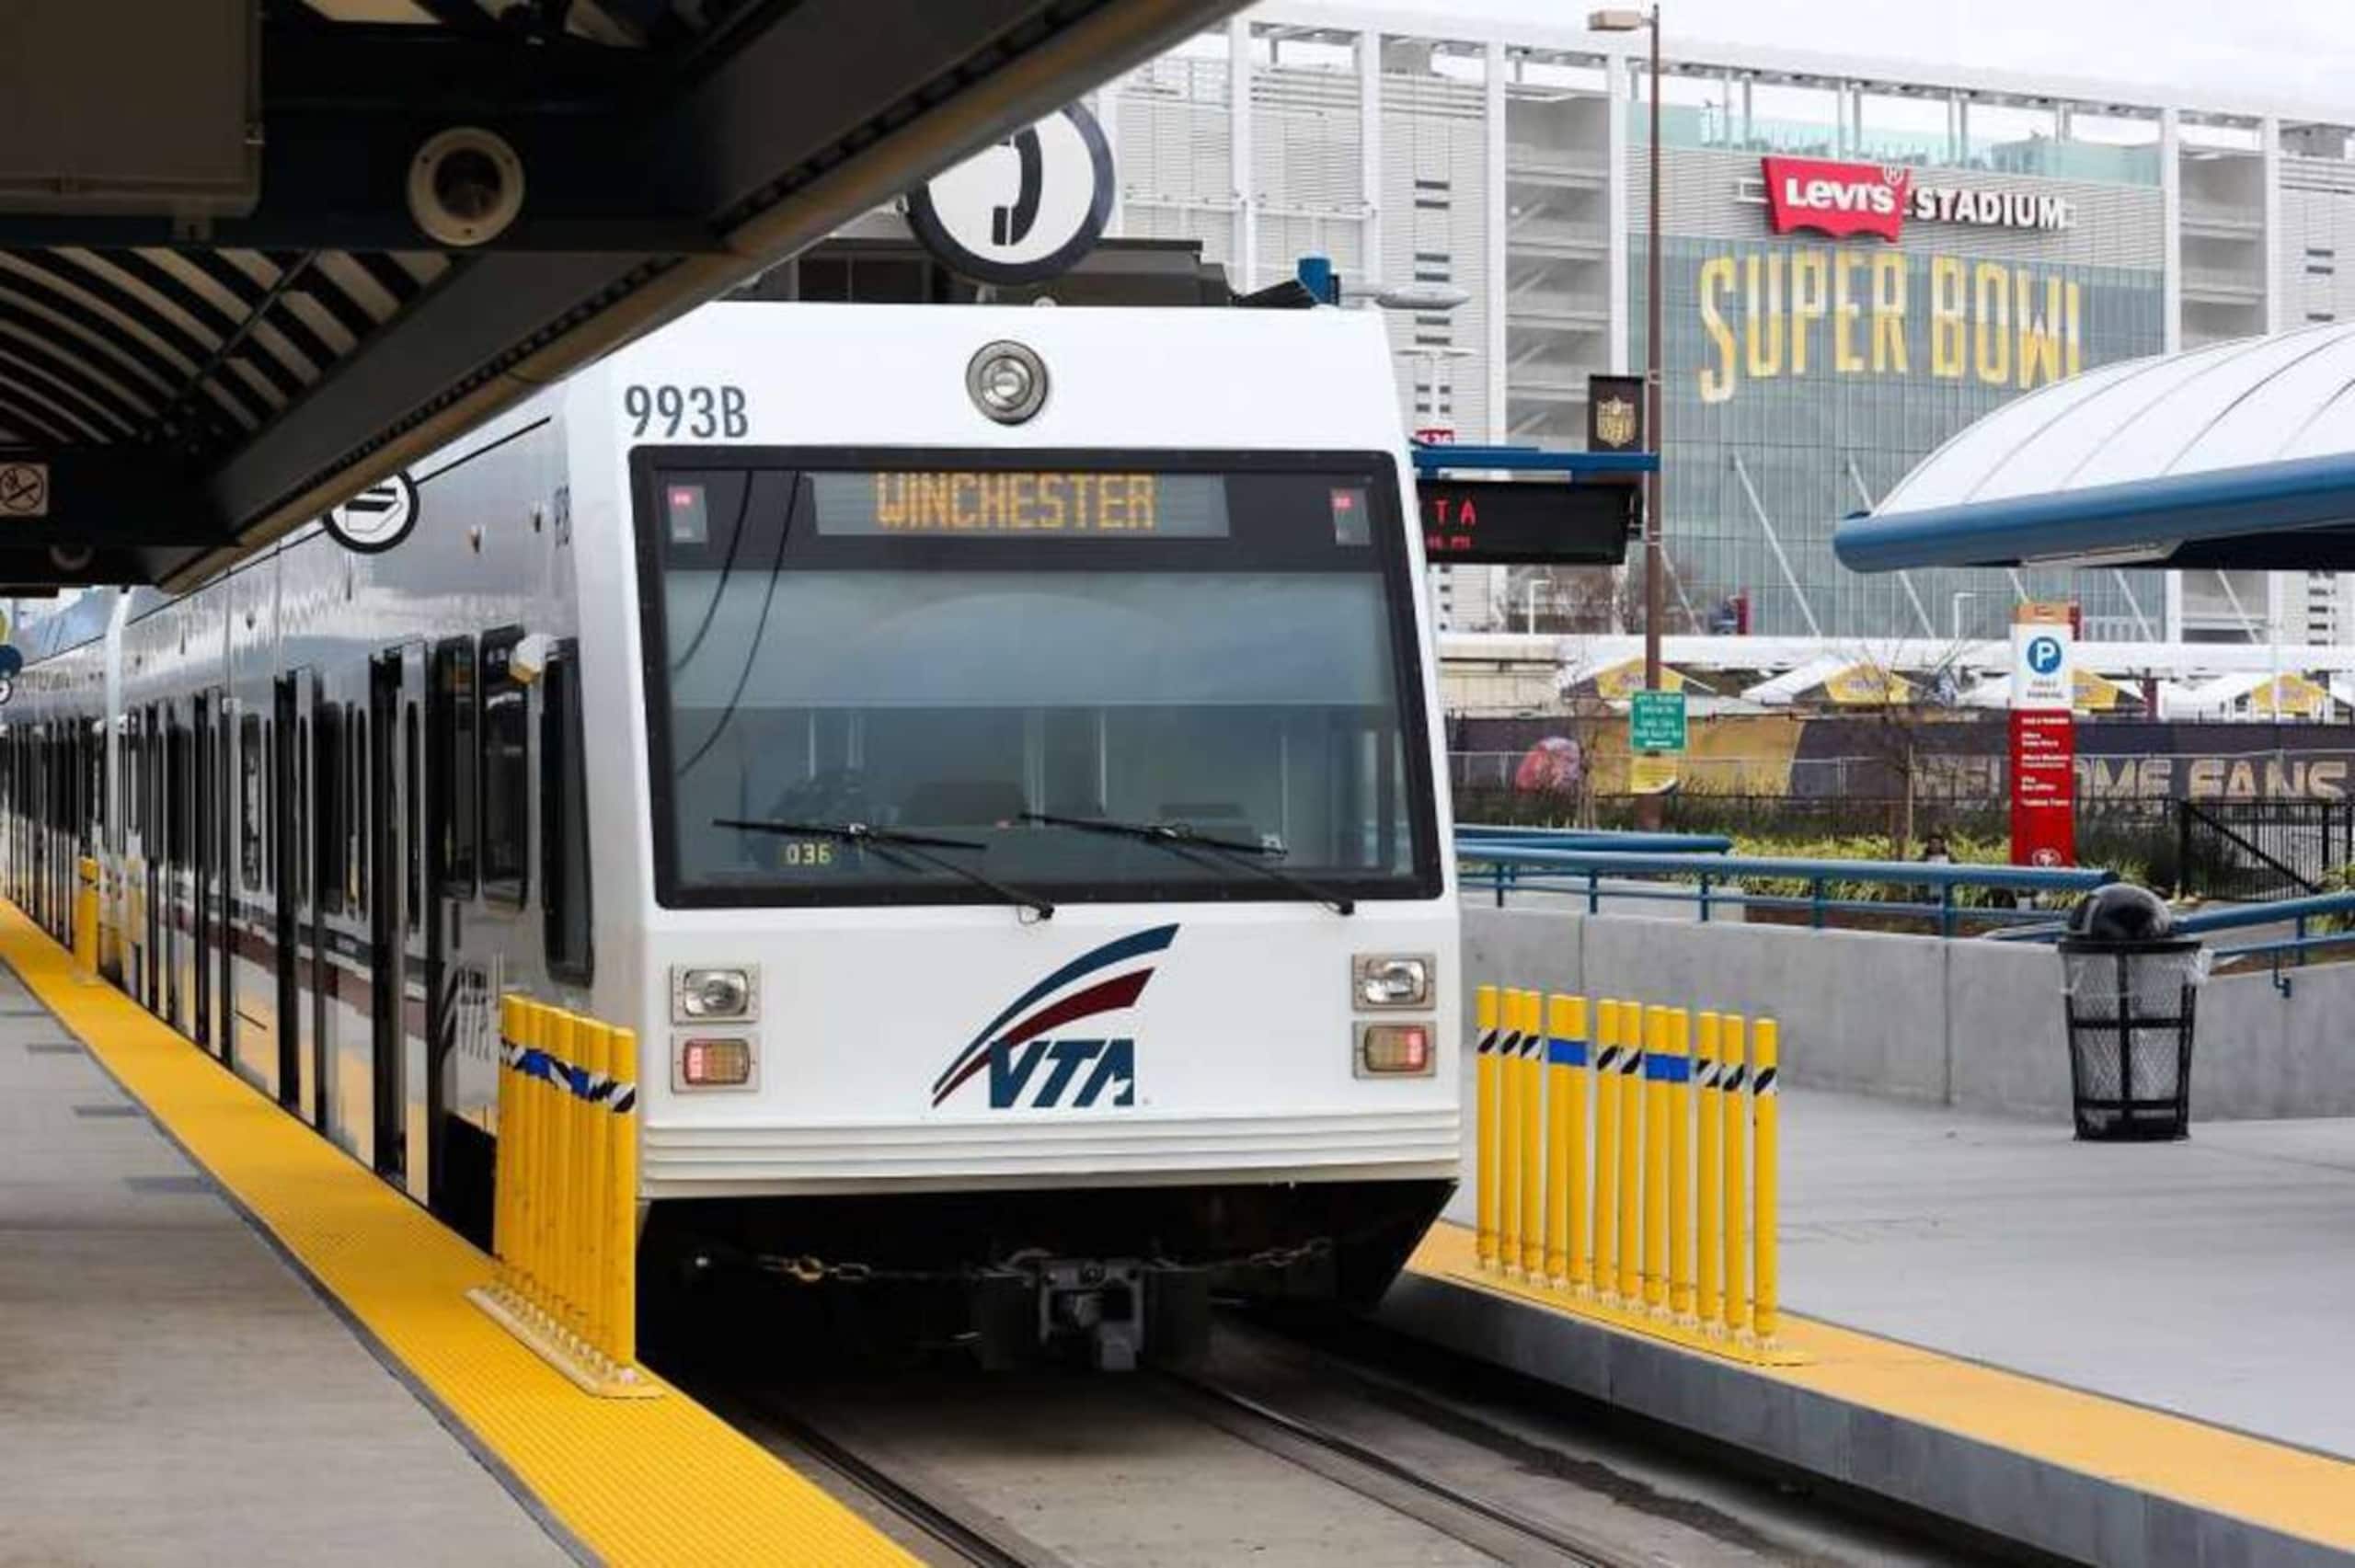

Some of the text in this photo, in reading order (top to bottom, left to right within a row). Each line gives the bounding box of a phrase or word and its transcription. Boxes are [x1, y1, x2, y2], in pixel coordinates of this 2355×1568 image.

[1916, 187, 2068, 229] STADIUM
[1700, 249, 1908, 403] SUPER
[626, 384, 748, 438] 993B
[877, 472, 1153, 529] WINCHESTER
[787, 843, 832, 864] 036
[990, 1039, 1134, 1108] VTA
